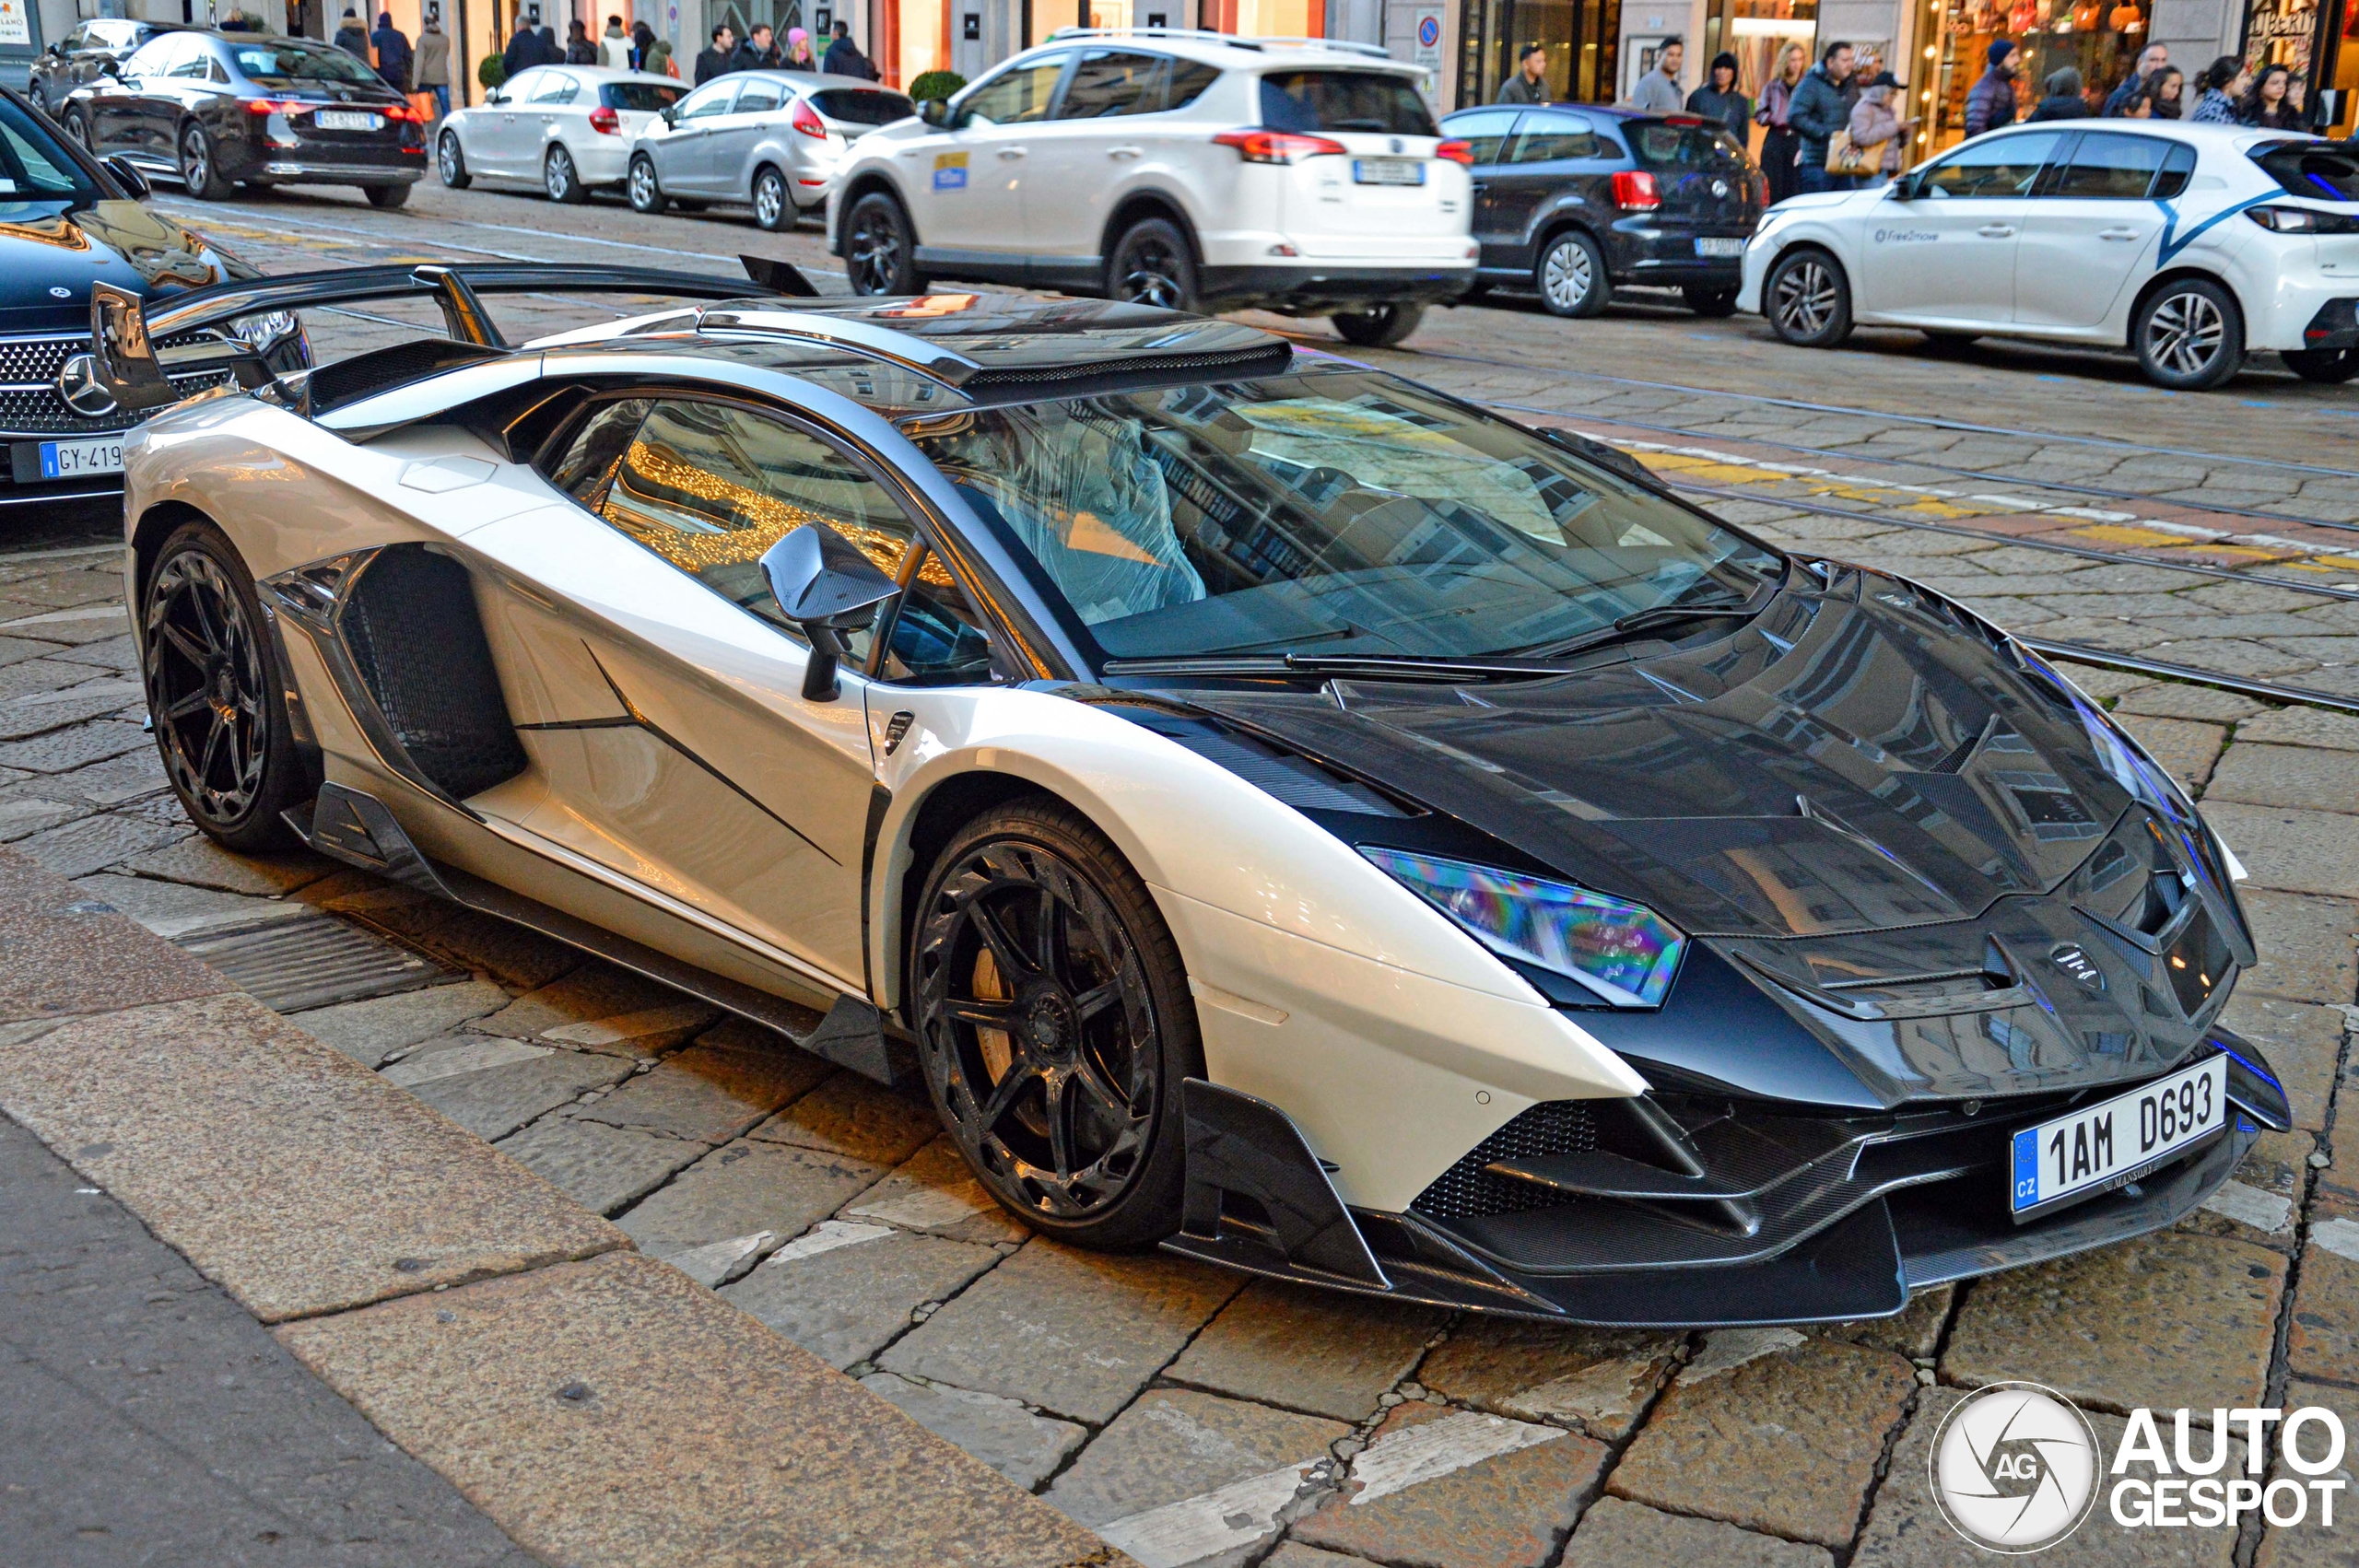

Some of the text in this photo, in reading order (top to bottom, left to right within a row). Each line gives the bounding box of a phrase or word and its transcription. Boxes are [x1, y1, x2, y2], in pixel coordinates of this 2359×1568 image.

[59, 446, 122, 470] GY 419
[2049, 1071, 2212, 1186] 1AM D693
[2017, 1177, 2036, 1198] CZ
[2113, 1163, 2153, 1189] MANSORY
